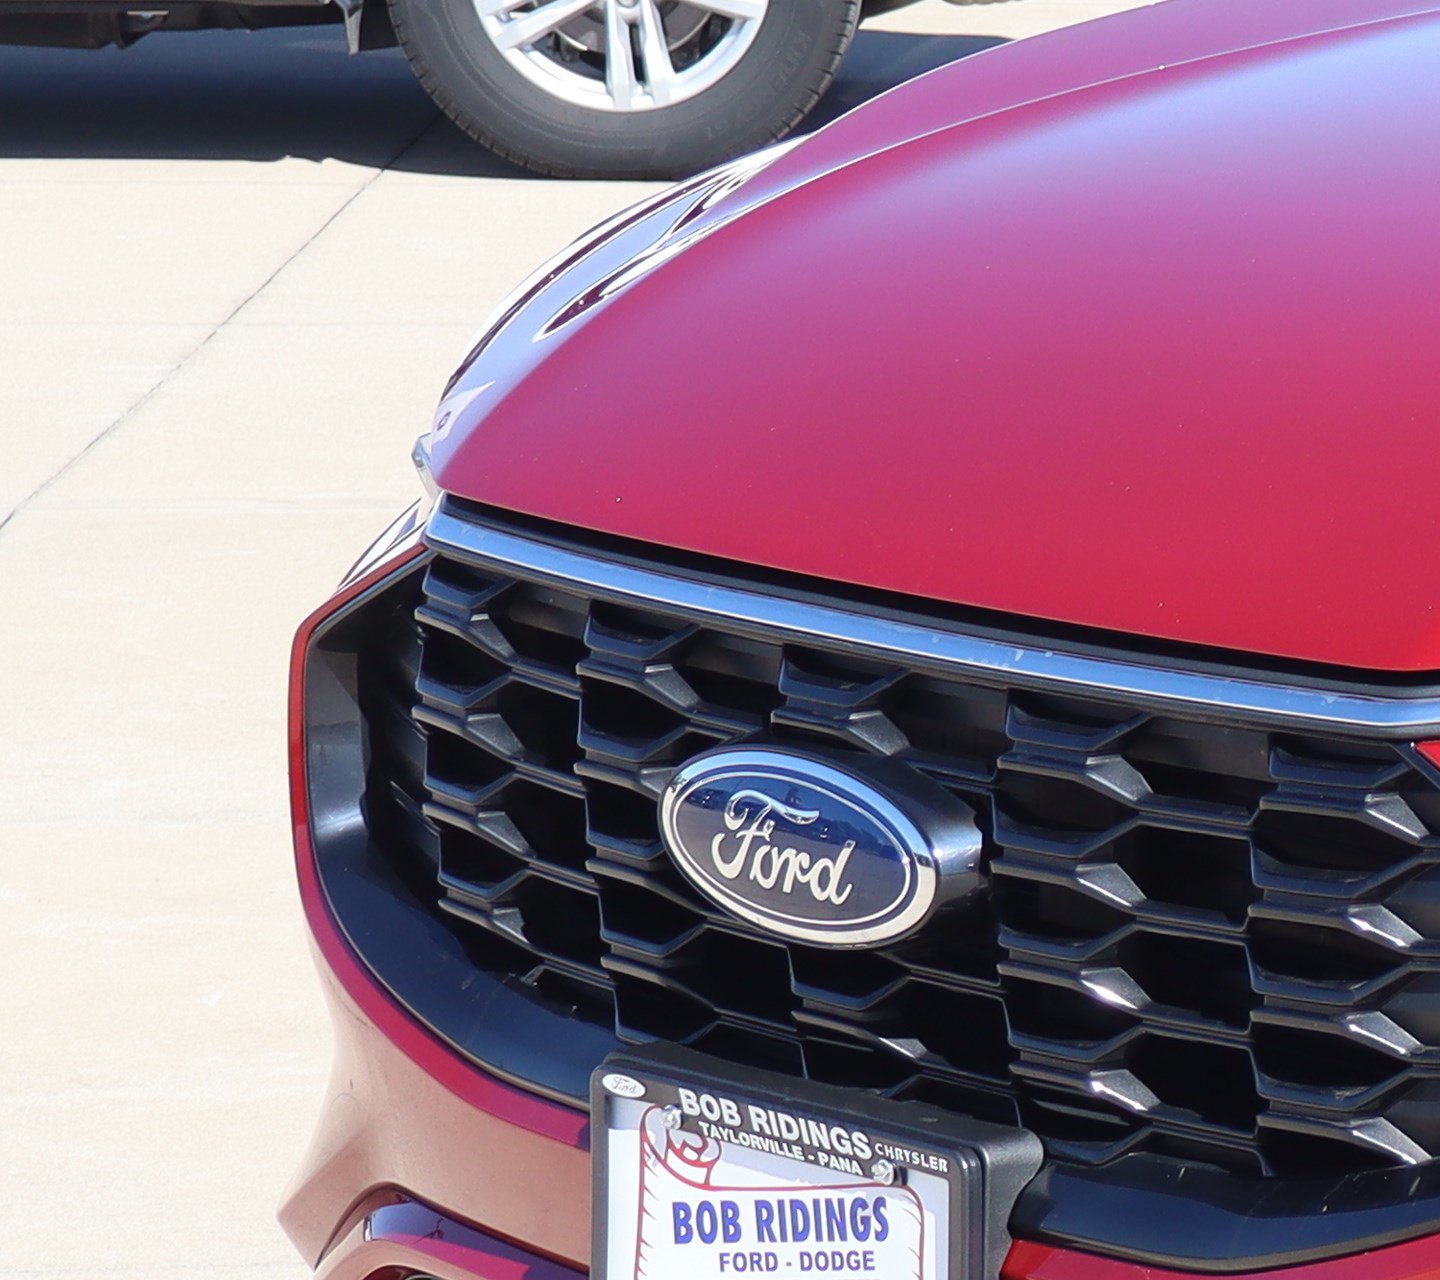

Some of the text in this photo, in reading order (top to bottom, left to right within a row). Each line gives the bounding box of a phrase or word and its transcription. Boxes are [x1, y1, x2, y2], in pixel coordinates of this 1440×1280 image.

[711, 789, 856, 906] Ford
[678, 1087, 873, 1160] BOB RIDINGS
[698, 1120, 805, 1161] TAYLORVILLE
[818, 1151, 864, 1177] PANA
[875, 1141, 948, 1173] CHRYSLER
[672, 1195, 890, 1245] BOB RIDINGS
[718, 1251, 780, 1273] FORD
[799, 1249, 876, 1272] DODGE
